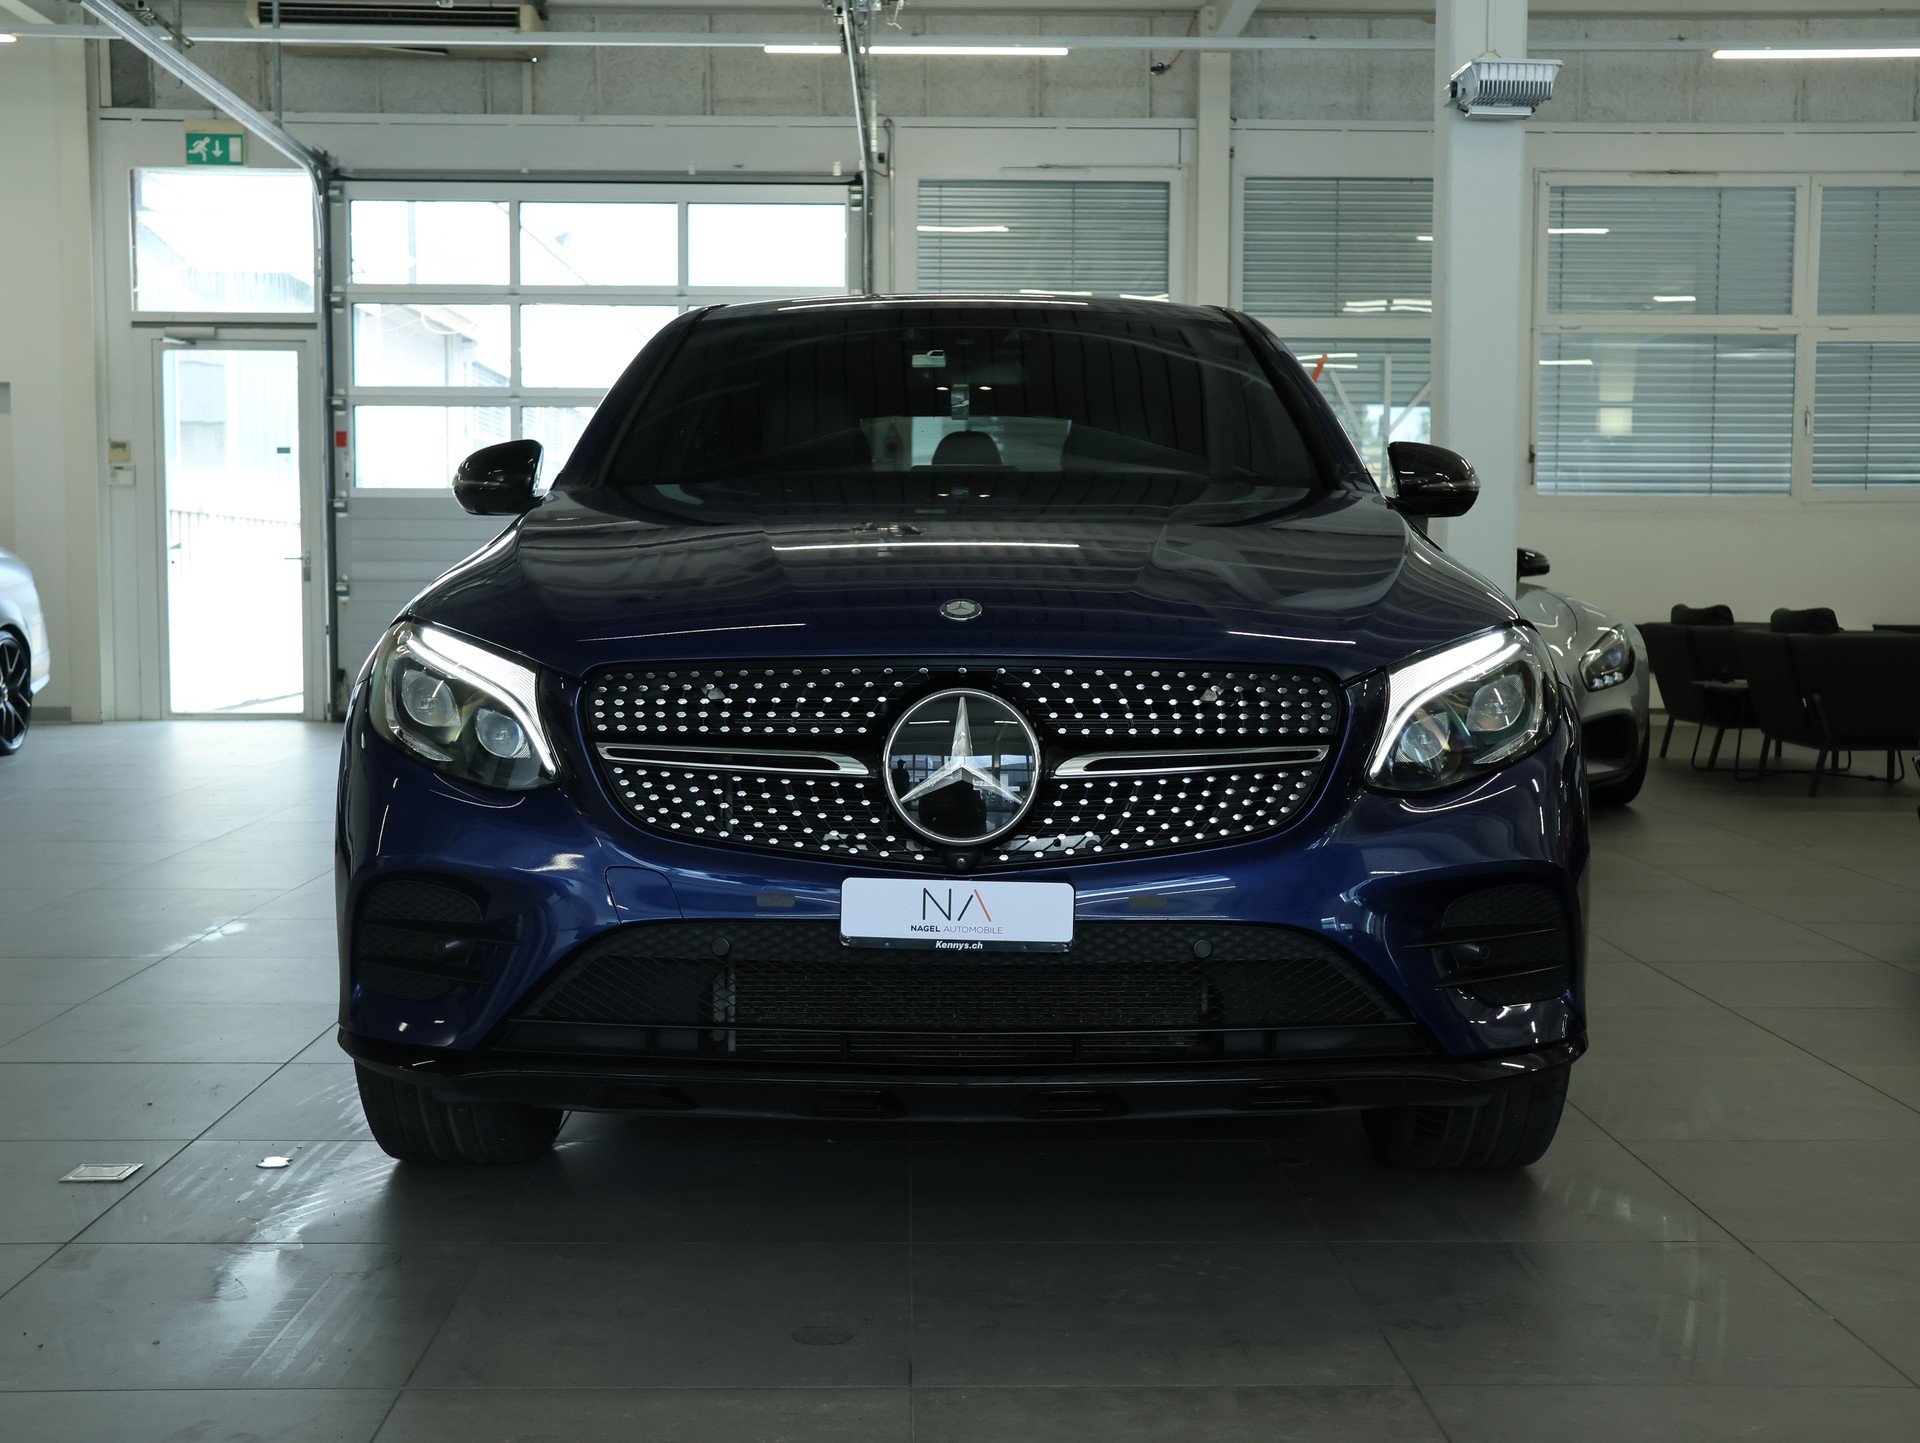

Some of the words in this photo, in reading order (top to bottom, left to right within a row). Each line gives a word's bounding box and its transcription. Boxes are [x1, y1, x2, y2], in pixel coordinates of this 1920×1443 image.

[910, 925, 941, 933] NAGEL
[943, 925, 1004, 935] AUTOMOBILE
[935, 940, 984, 950] Kennys.ch
